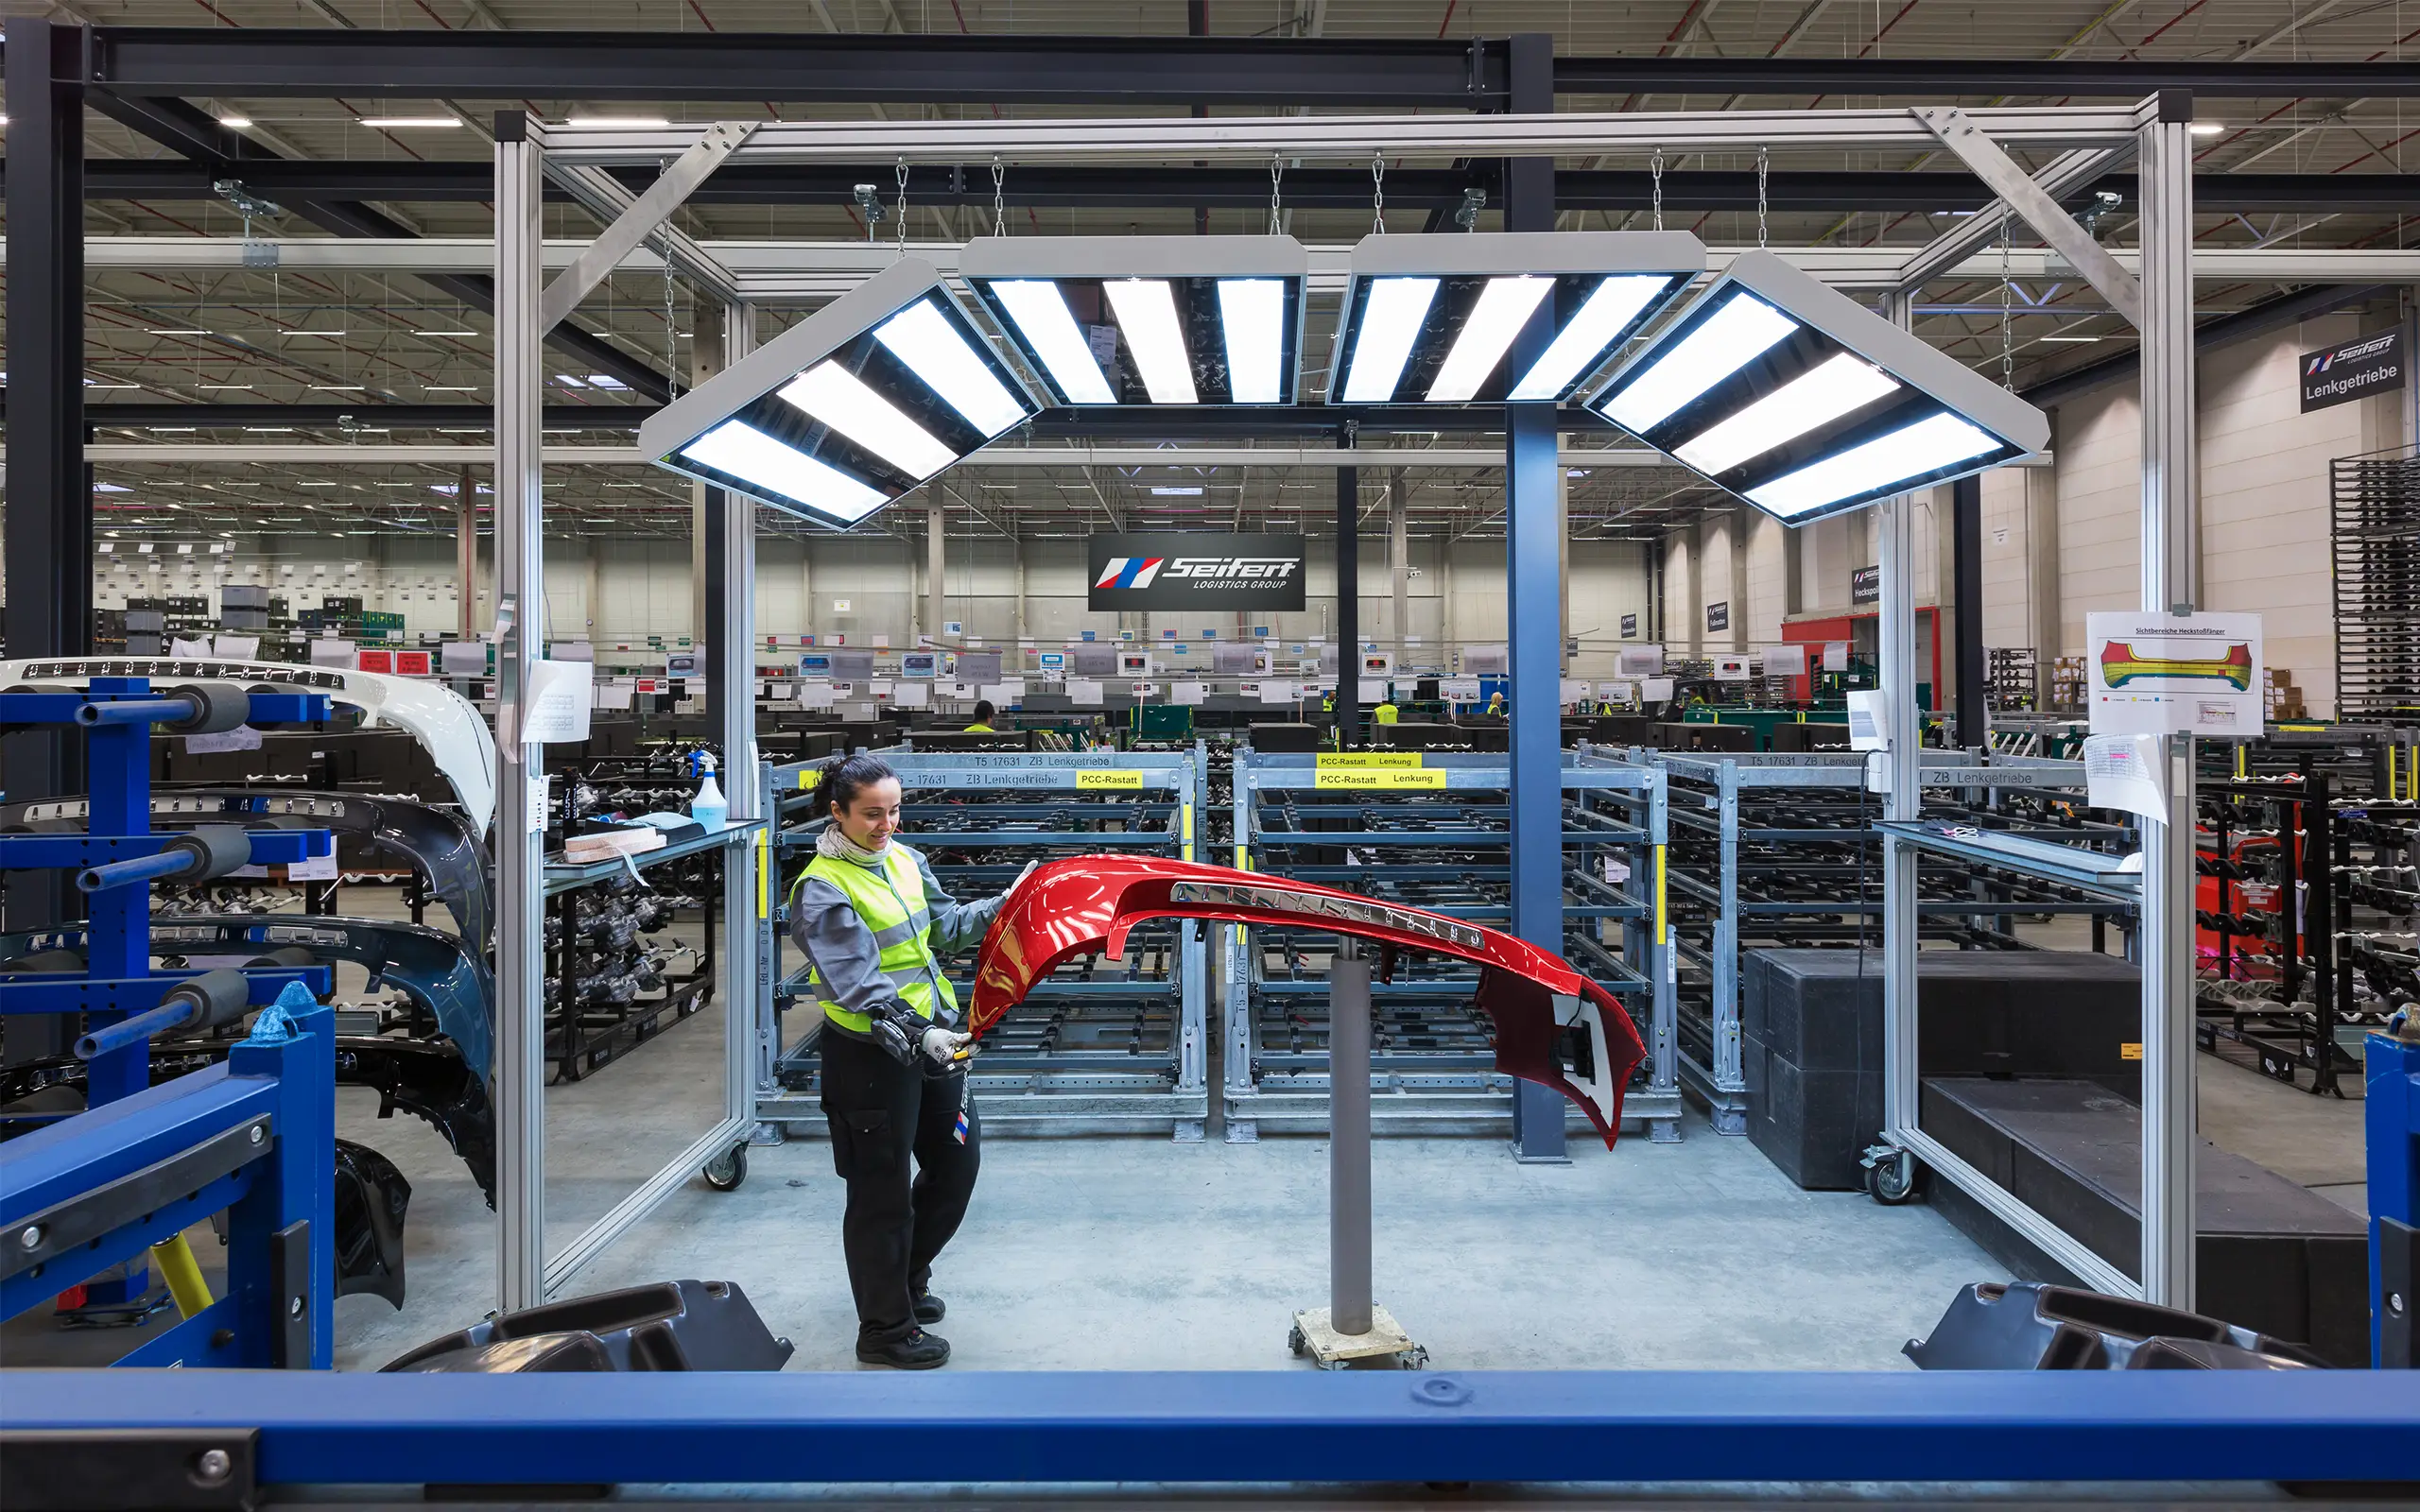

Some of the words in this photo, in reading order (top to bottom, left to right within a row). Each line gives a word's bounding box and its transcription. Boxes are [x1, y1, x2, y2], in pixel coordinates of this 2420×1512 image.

[2334, 334, 2395, 363] Seifert
[2307, 366, 2397, 400] Lenkgetriebe
[1162, 558, 1301, 577] Seifert
[1193, 580, 1248, 589] LOGISTICS
[1251, 580, 1287, 589] GROUP
[975, 757, 987, 766] T5
[993, 757, 1020, 766] 17631
[1029, 757, 1043, 766] ZB
[1048, 757, 1110, 768] Lenkgetriebe
[1379, 758, 1411, 766] Lenkung
[1751, 757, 1763, 765] T5
[1769, 757, 1795, 765] 17631
[1805, 757, 1818, 765] ZB
[917, 775, 945, 784] 17631
[966, 775, 980, 784] ZB
[984, 774, 1058, 786] Lenkgetriebe
[1081, 776, 1137, 785] PCC-Rastatt
[1321, 775, 1376, 784] PCC-Rastatt
[1393, 774, 1433, 783] Lenkung
[1933, 772, 1949, 782] ZB
[1958, 771, 2031, 785] Lenkgetriebe
[1236, 957, 1246, 986] 17631
[1236, 998, 1246, 1014] T5
